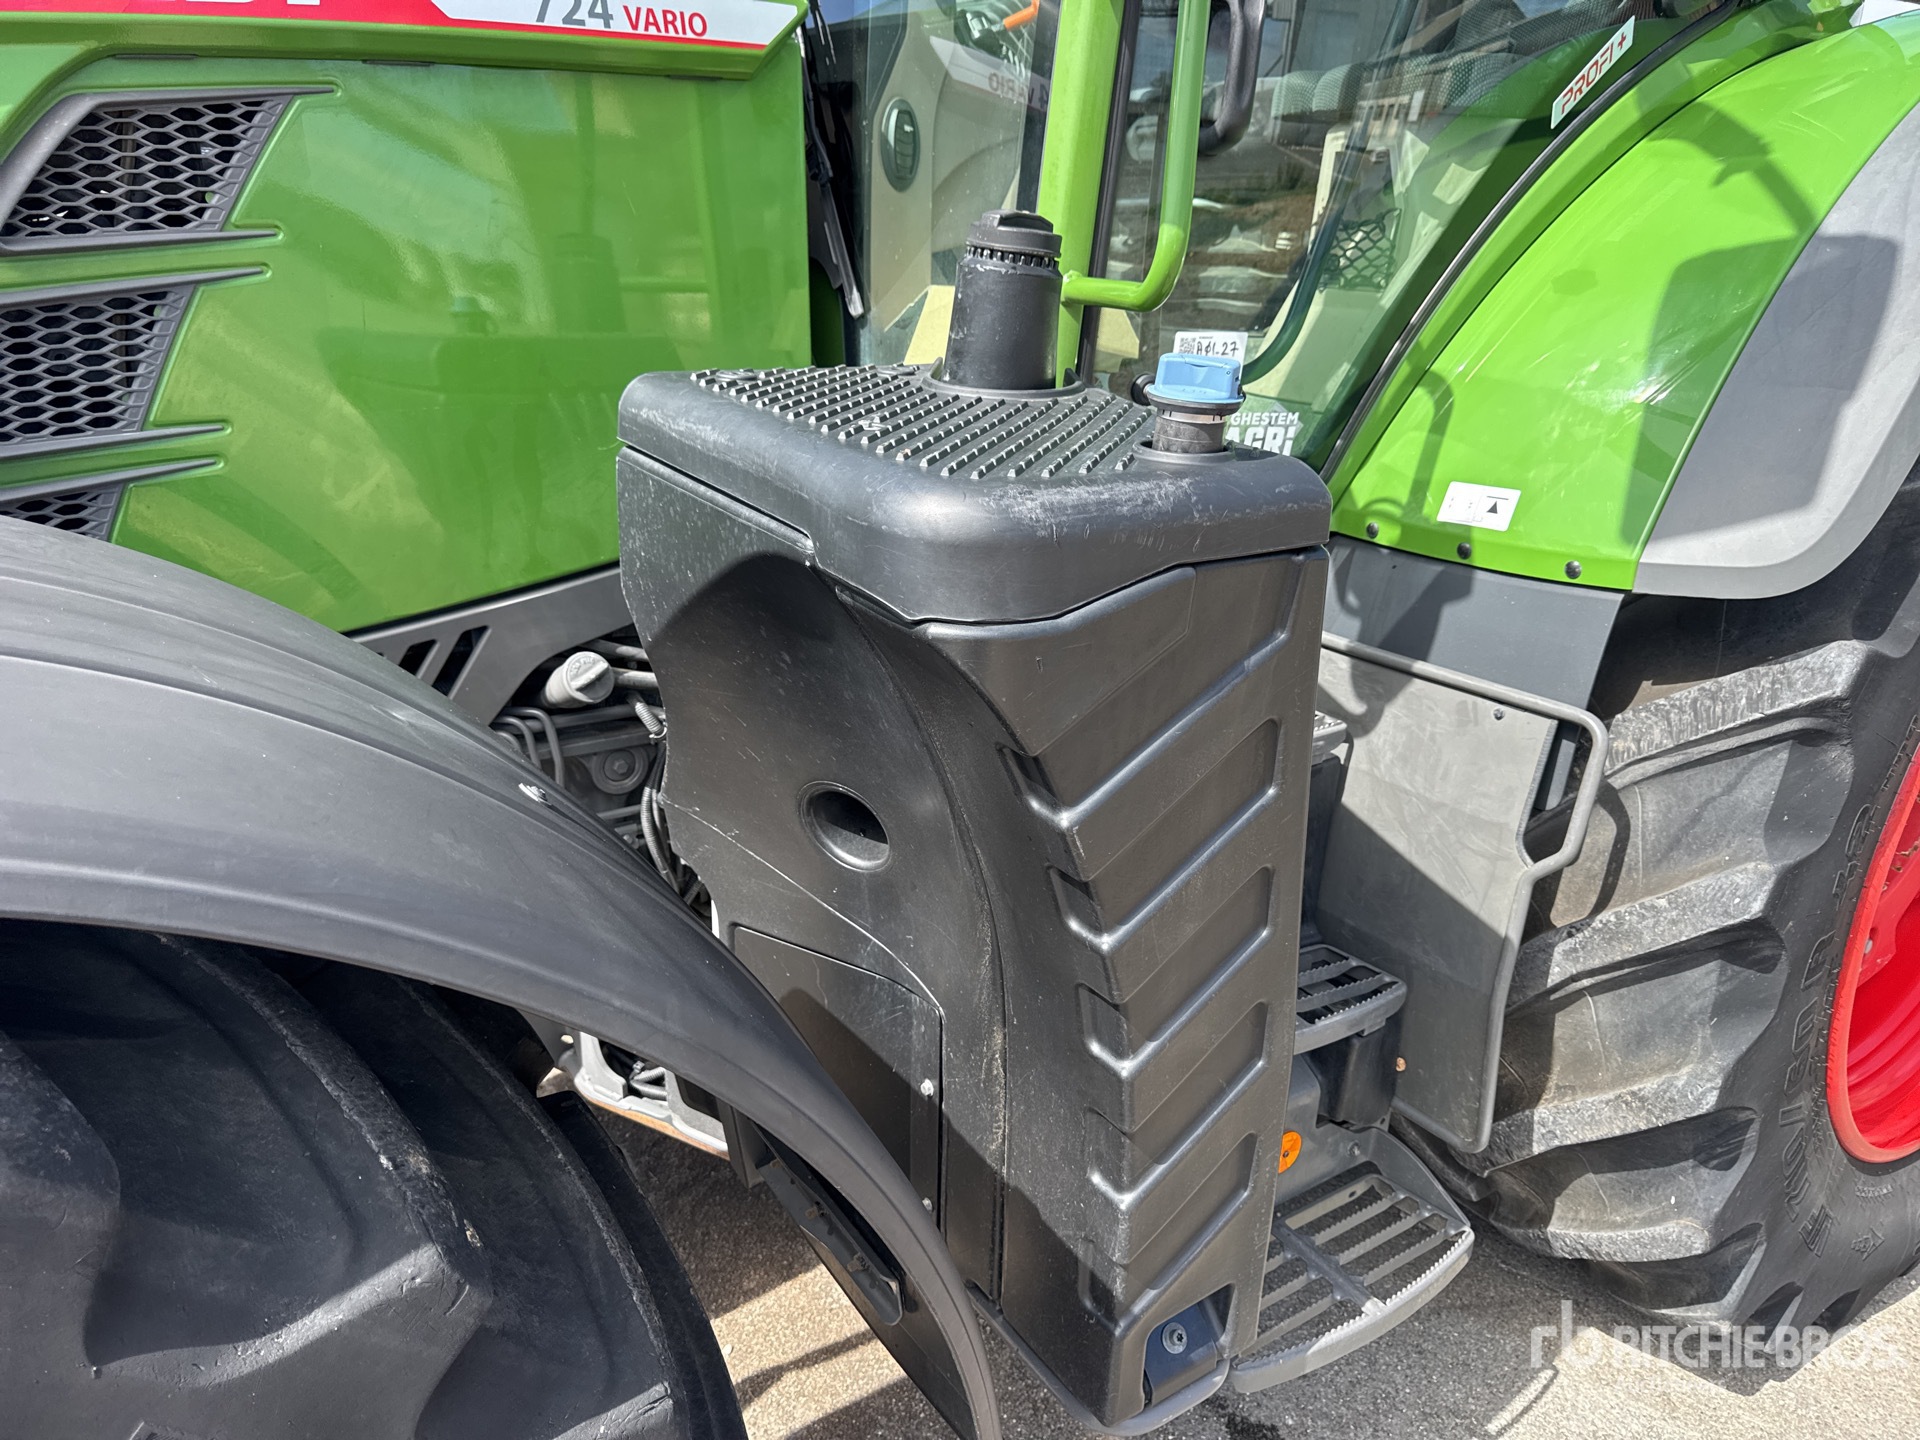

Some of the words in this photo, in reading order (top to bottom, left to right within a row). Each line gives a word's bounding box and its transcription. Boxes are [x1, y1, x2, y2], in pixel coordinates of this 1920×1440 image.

[623, 5, 707, 37] VARIO
[1561, 42, 1614, 115] PROFI
[1230, 411, 1300, 426] GHESTEM
